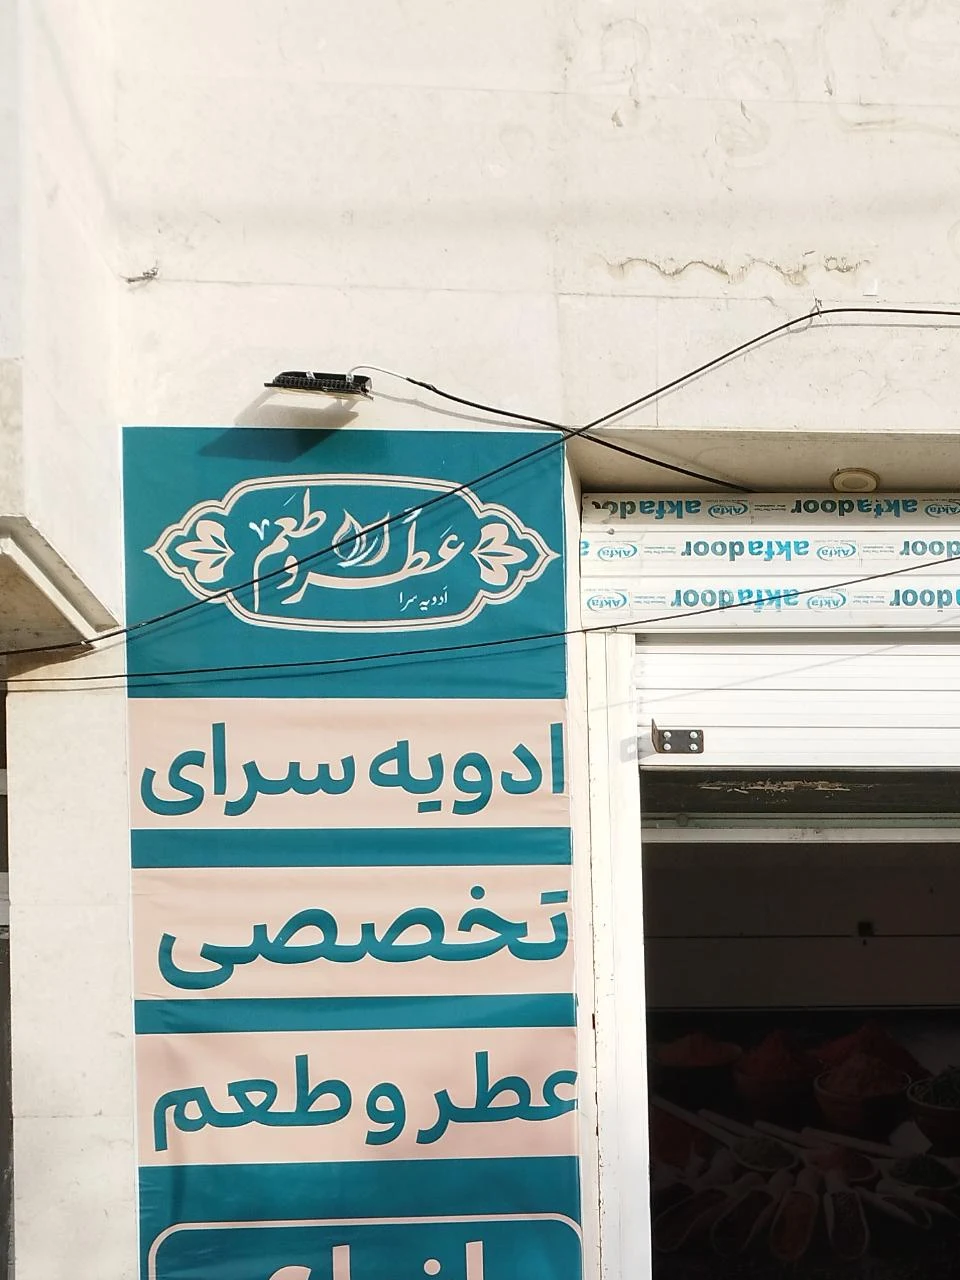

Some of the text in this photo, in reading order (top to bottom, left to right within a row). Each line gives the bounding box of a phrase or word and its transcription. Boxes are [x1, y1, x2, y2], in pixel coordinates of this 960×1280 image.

[681, 540, 810, 561] akfadoor
[139, 721, 566, 817] ادویه سرای
[158, 884, 570, 991] تخصصی
[152, 1050, 579, 1153] عطر و طعم
